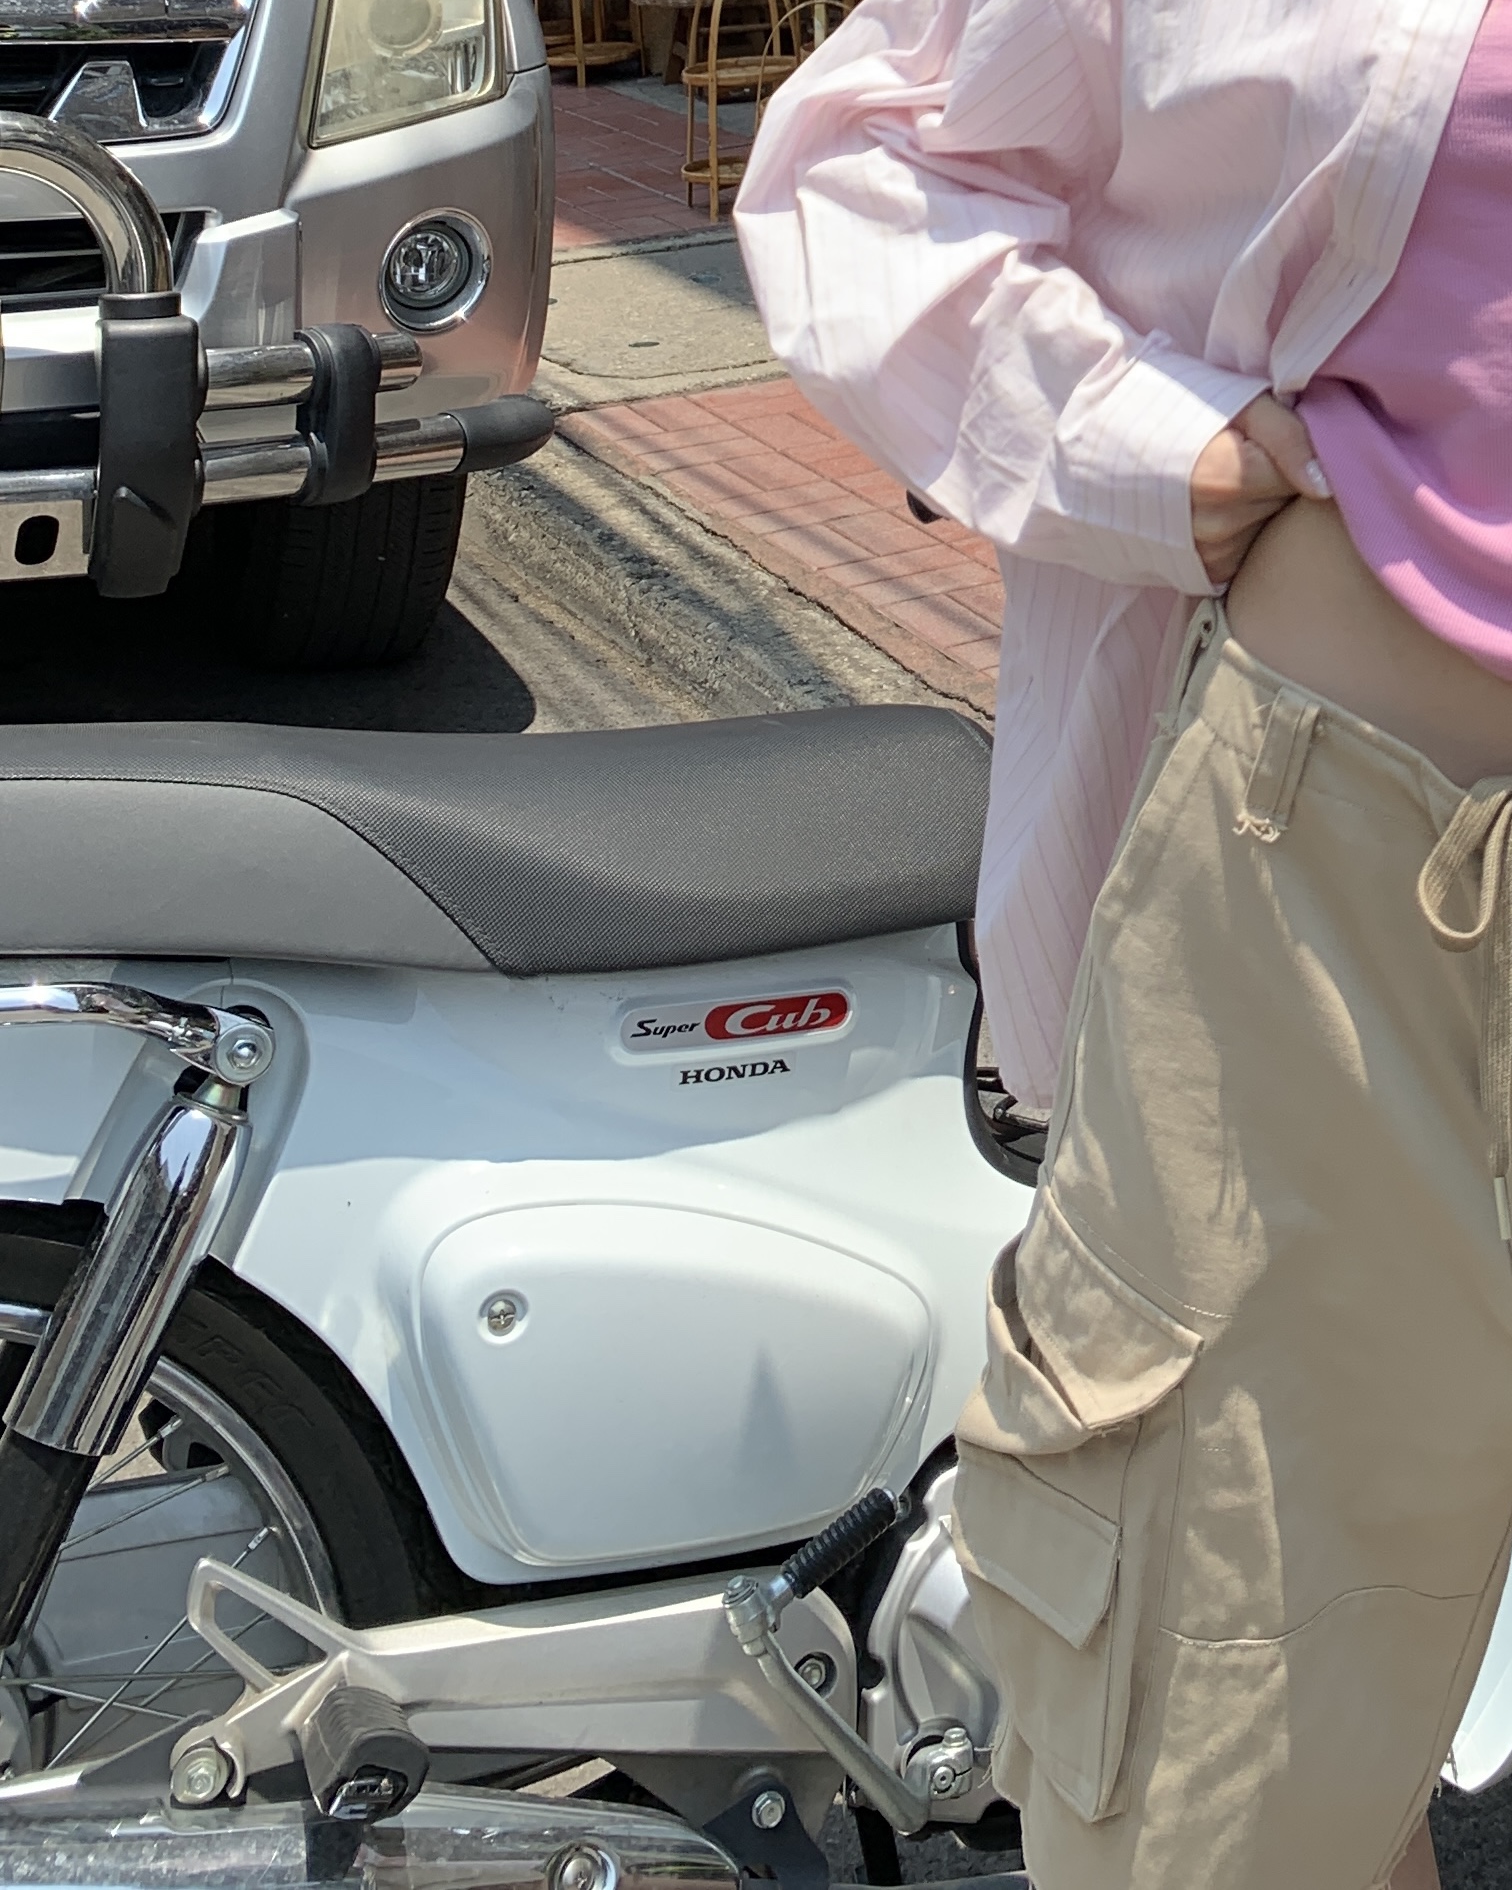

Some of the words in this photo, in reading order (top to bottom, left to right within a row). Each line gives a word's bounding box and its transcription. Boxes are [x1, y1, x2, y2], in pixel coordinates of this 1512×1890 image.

[630, 1019, 700, 1039] Super
[724, 998, 832, 1036] Cub
[678, 1059, 791, 1086] HONDA
